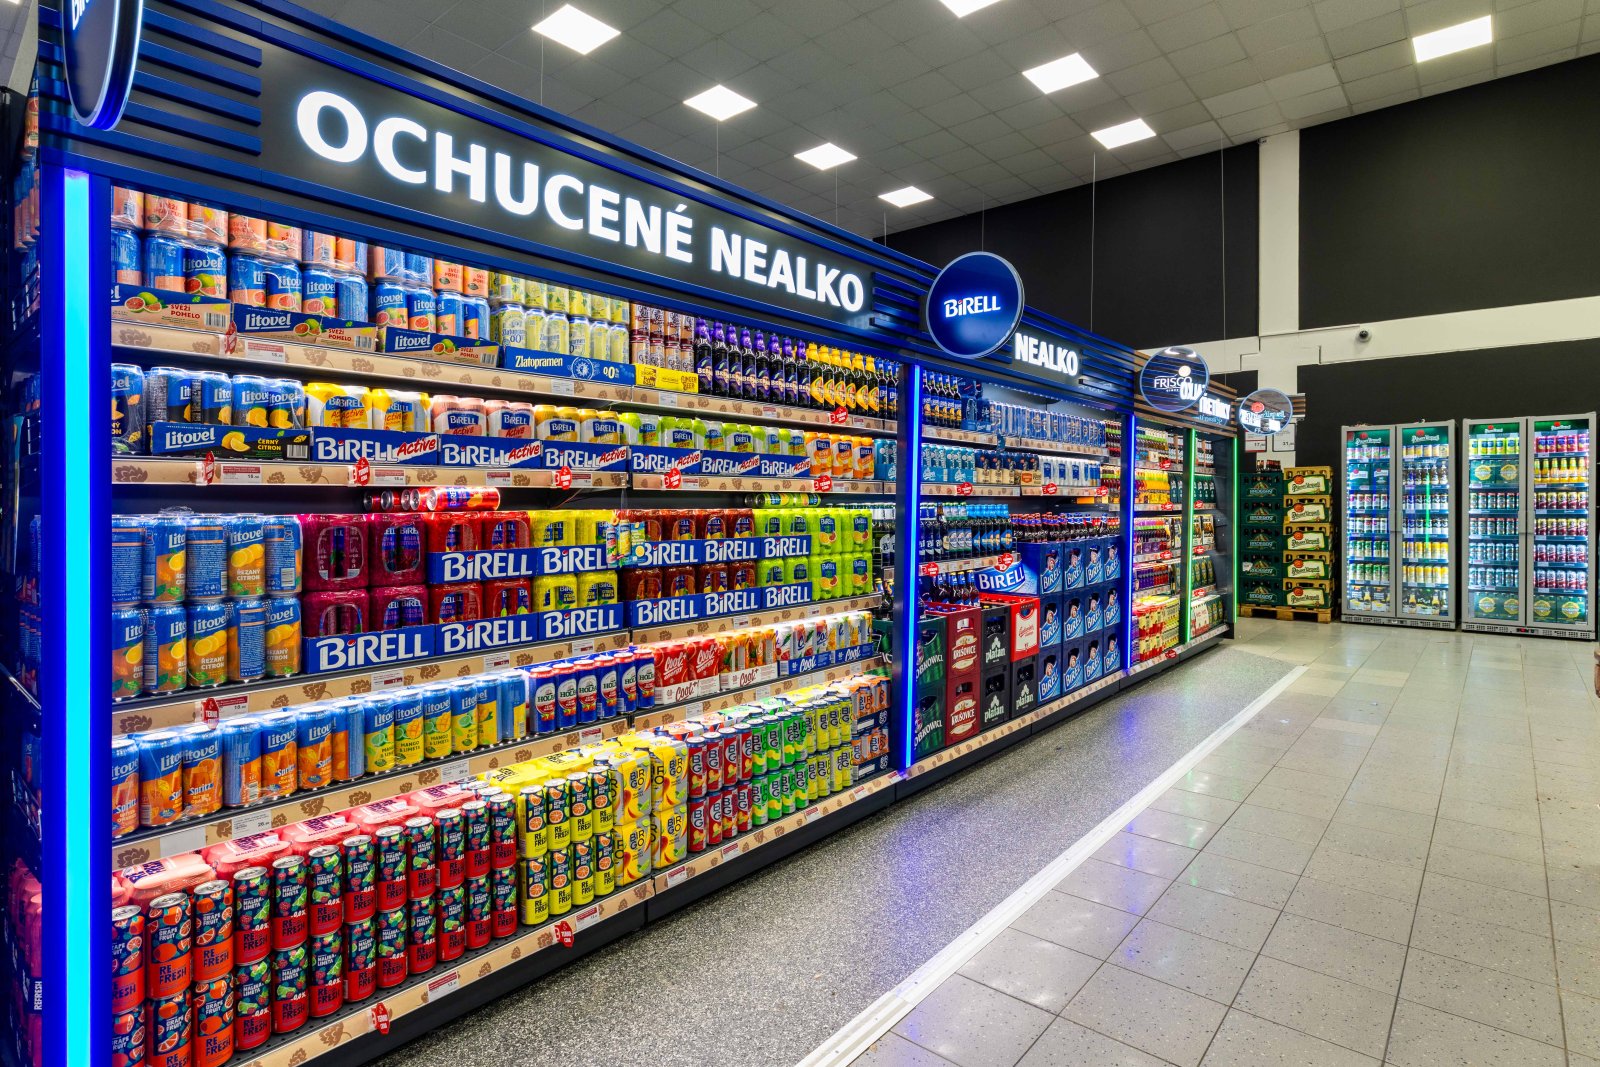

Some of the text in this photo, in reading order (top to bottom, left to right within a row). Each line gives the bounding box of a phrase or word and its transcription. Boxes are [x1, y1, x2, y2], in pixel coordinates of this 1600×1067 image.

[295, 90, 864, 312] OCHUCENÉ NEALKO
[170, 311, 201, 321] POMELO
[245, 313, 291, 331] Litovel
[395, 335, 431, 351] Litovel
[1015, 332, 1079, 377] NEALKO
[515, 355, 563, 371] Zlatopramen
[165, 427, 216, 450] Litovel
[258, 445, 282, 453] CITRON
[397, 437, 437, 457] Active
[508, 442, 540, 462] Active
[599, 447, 627, 465] Active
[676, 451, 701, 468] Active
[739, 456, 760, 472] Active
[979, 567, 1025, 590] BIRELL
[985, 647, 1006, 663] platan
[1016, 693, 1034, 709] platan
[984, 705, 1004, 723] platan
[203, 949, 214, 959] RE
[203, 952, 229, 967] FRESH
[159, 967, 186, 983] FRESH
[160, 964, 172, 975] RE
[33, 980, 42, 1011] REFRESH
[206, 1037, 218, 1047] RE
